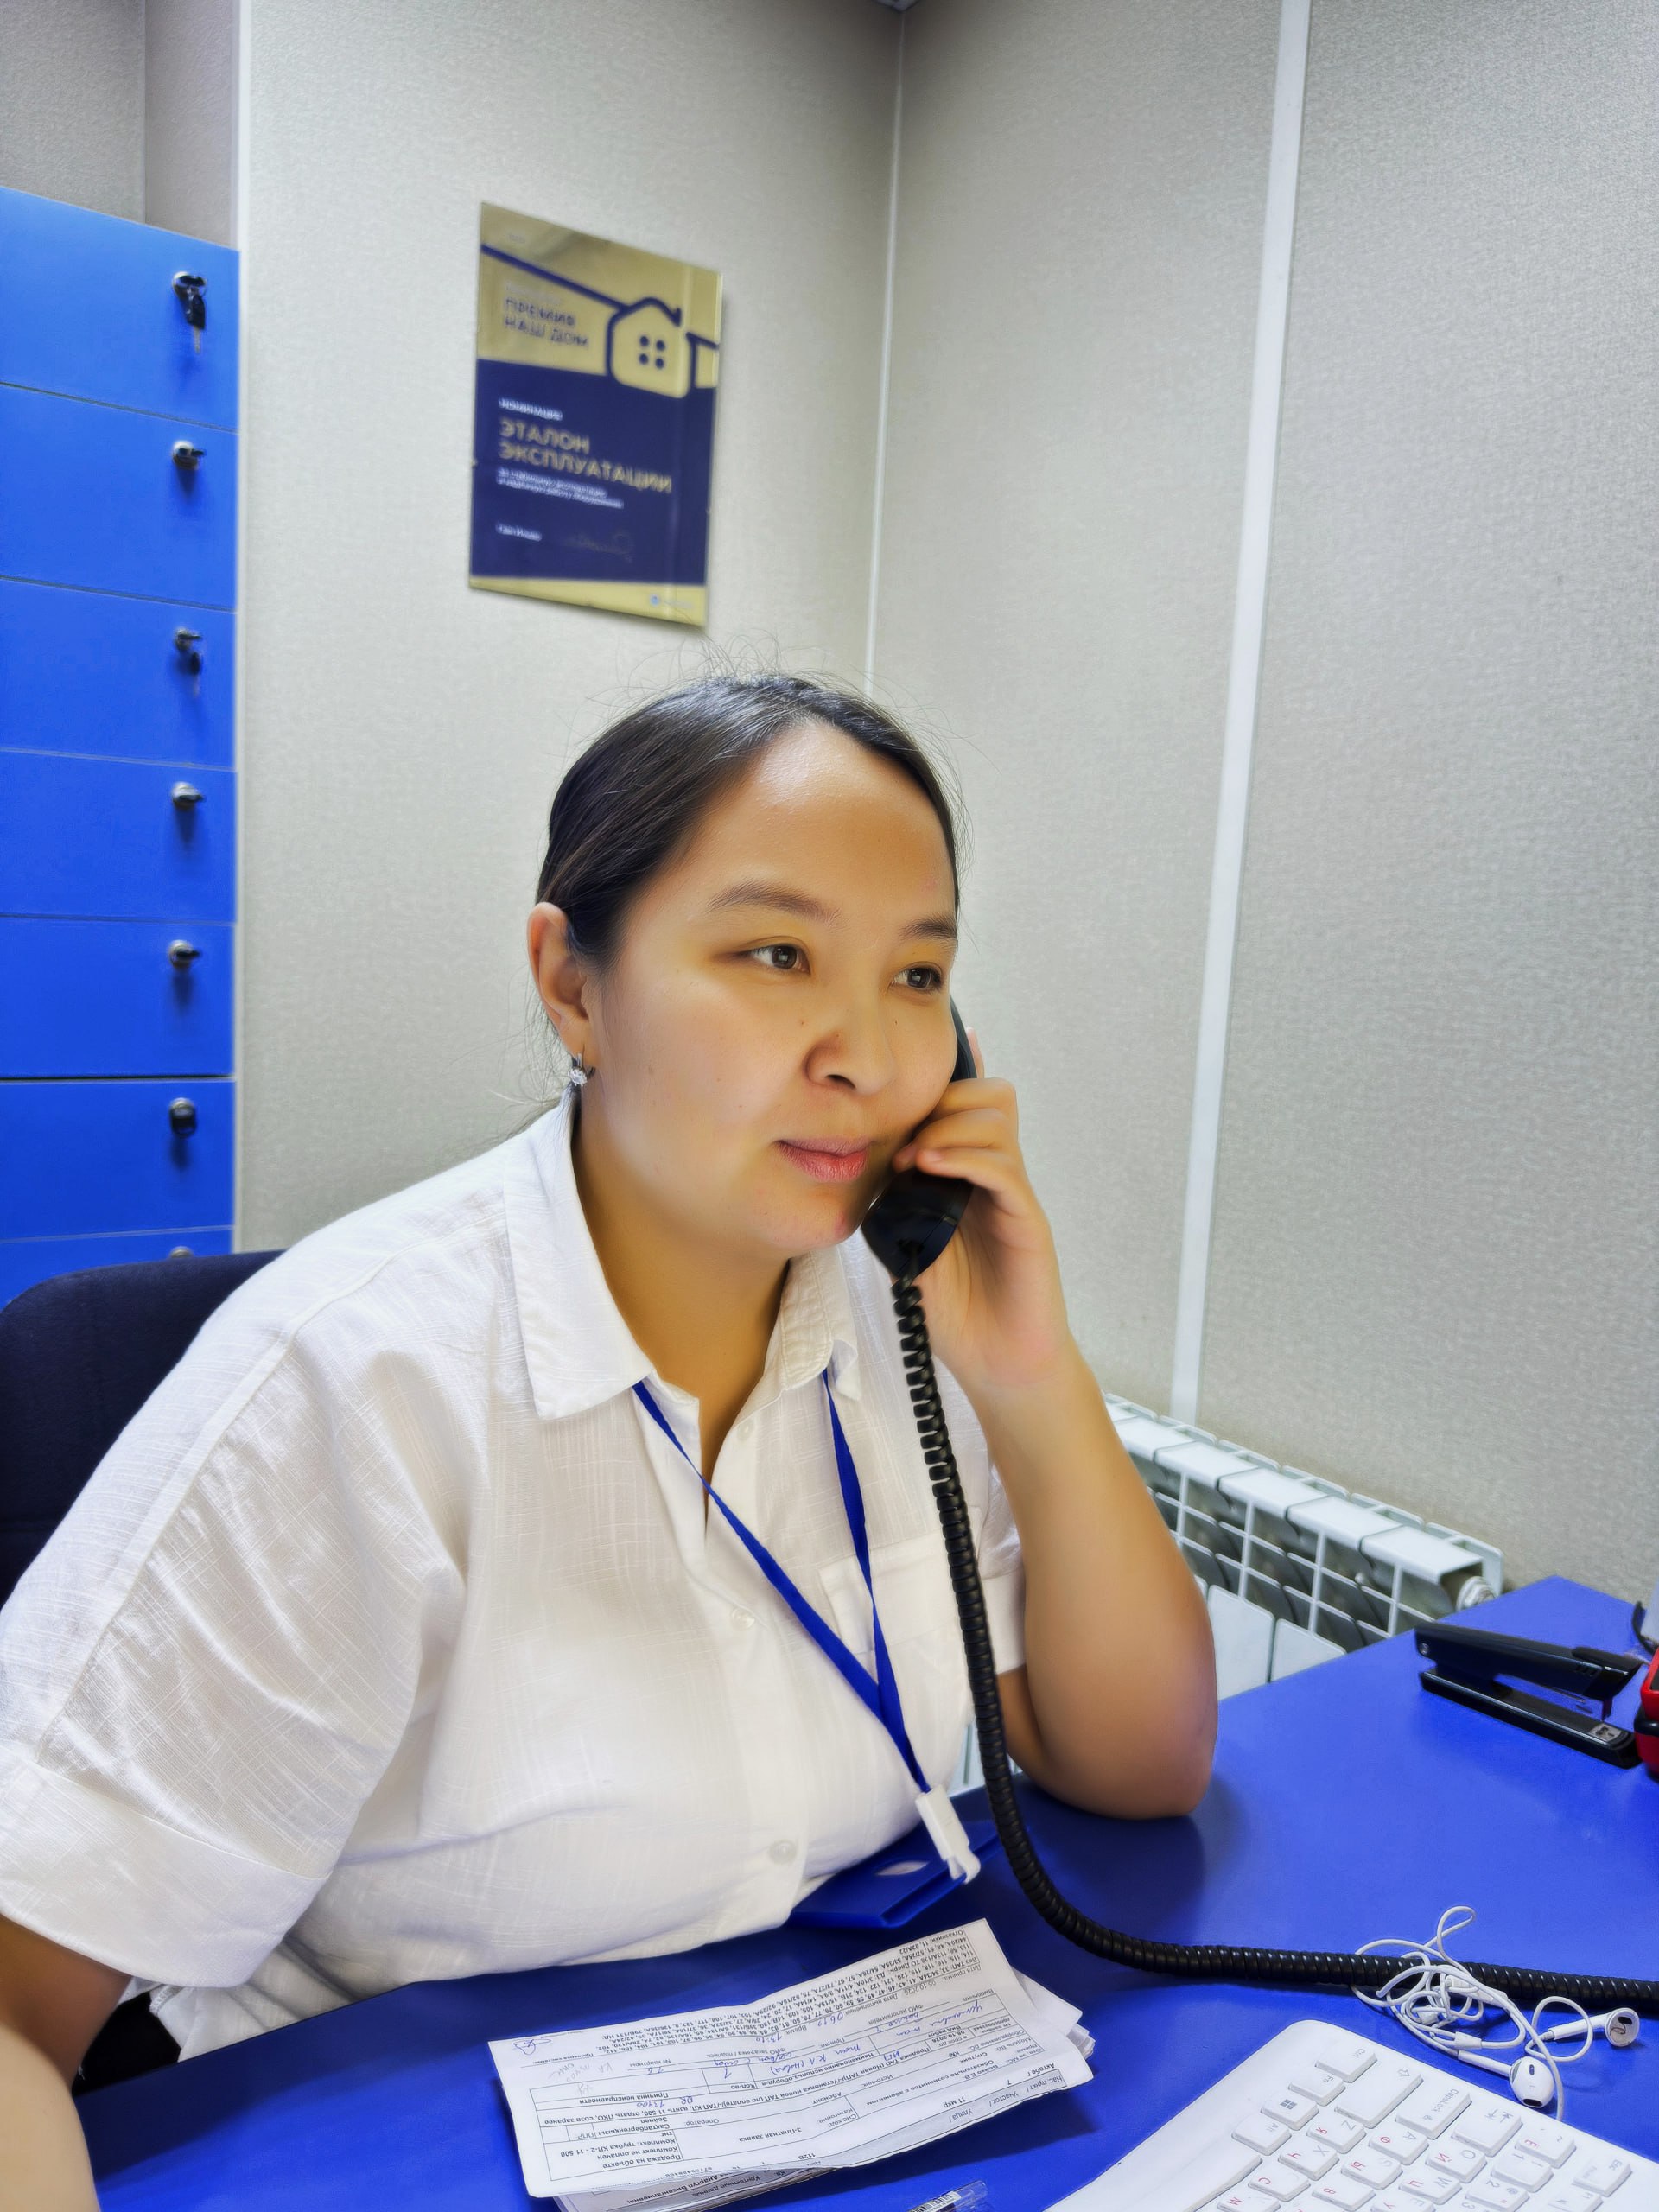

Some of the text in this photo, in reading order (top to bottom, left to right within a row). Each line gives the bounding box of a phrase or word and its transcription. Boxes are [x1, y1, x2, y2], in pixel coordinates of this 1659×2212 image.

[500, 419, 590, 454] ЭТАЛОН
[499, 441, 672, 493] ЭКСПЛУАТАЦИИ
[965, 1963, 981, 1974] Дата
[882, 1993, 898, 2002] Дата
[868, 2003, 923, 2025] ФИО исполнителя
[927, 2027, 946, 2037] работ
[898, 2046, 929, 2061] Продажа
[959, 2050, 987, 2063] Спутник
[823, 2050, 874, 2070] Наименование
[884, 2057, 898, 2066] ТАП
[860, 2062, 884, 2074] (Новая
[949, 2059, 994, 2077] Обязательно
[1030, 2062, 1055, 2075] Актобе
[1029, 2079, 1046, 2089] пункт
[1322, 2074, 1334, 2083] Fn
[729, 2081, 754, 2092] Кол-во
[578, 2089, 668, 2107] Причина неисправности
[764, 2094, 779, 2102] ТАП
[779, 2088, 801, 2098] новой
[812, 2091, 842, 2104] Абонент
[866, 2090, 904, 2106] абонентом
[991, 2090, 1018, 2104] Участок
[942, 2099, 957, 2108] мкр
[594, 2113, 613, 2122] ПКО,
[614, 2111, 639, 2120] отдать
[639, 2114, 667, 2124] Зейнеп
[950, 2107, 973, 2120] Улица
[543, 2117, 574, 2126] заранее
[1340, 2120, 1357, 2131] Z
[738, 2126, 801, 2142] 3-Платная заявка
[1315, 2126, 1328, 2135] Я
[1402, 2131, 1418, 2141] A
[609, 2141, 634, 2150] трубка
[638, 2138, 675, 2146] Комплект:
[596, 2151, 629, 2159] оплачен
[642, 2145, 677, 2154] Комплект
[1313, 2145, 1330, 2157] X
[601, 2158, 633, 2169] объекте
[645, 2153, 680, 2164] Продажа
[1434, 2152, 1452, 2164] Й
[1351, 2161, 1366, 2171] Ы
[719, 2175, 760, 2189] Контактные
[1435, 2177, 1452, 2188] W
[1484, 2179, 1501, 2189] 2
[691, 2184, 718, 2196] данные
